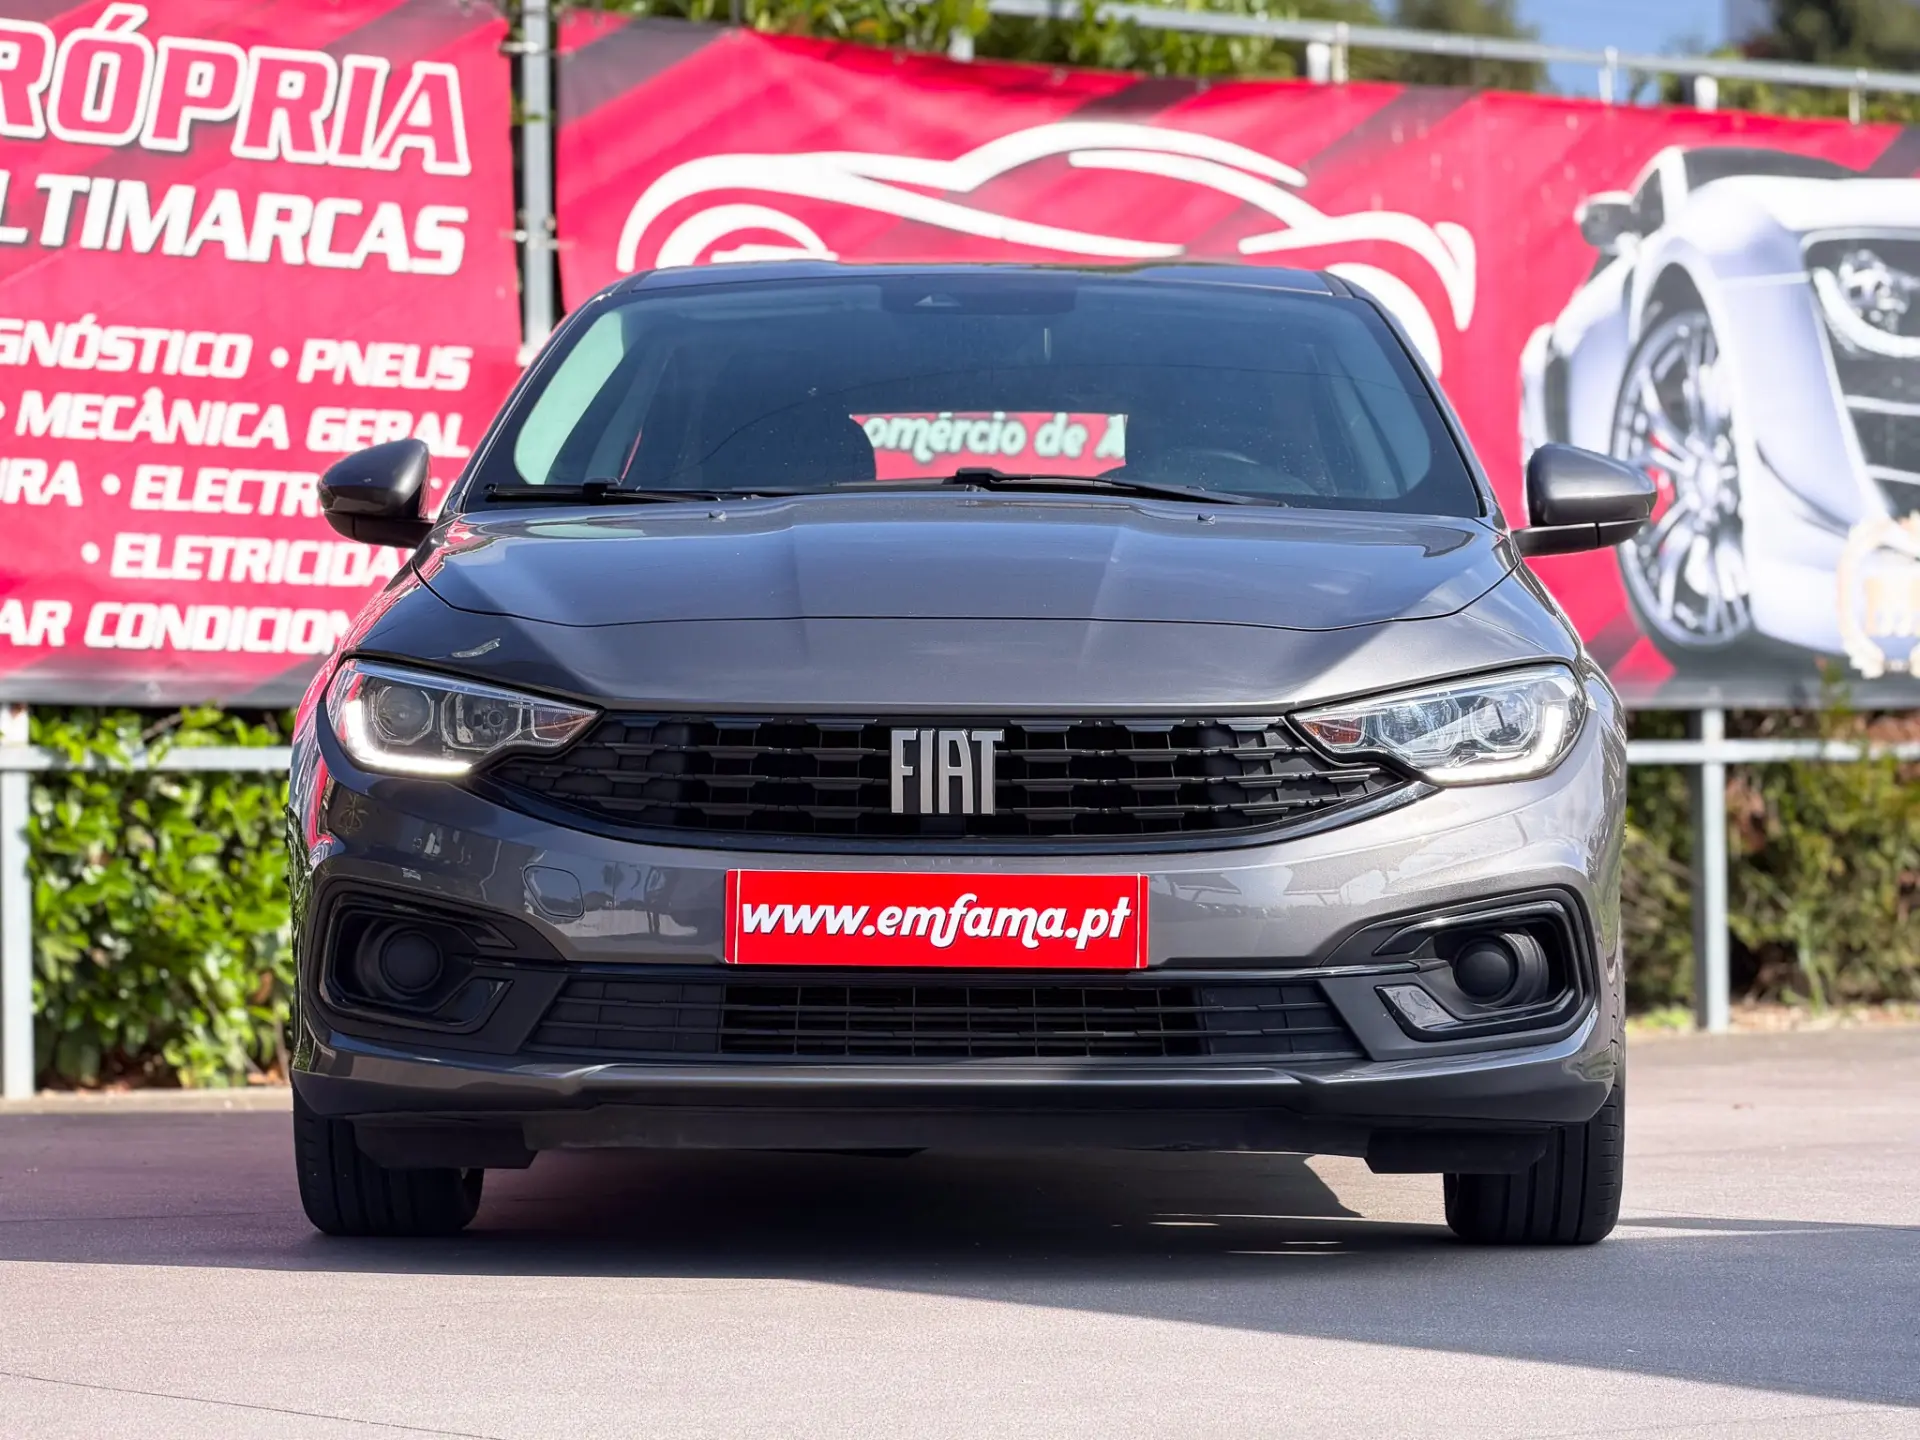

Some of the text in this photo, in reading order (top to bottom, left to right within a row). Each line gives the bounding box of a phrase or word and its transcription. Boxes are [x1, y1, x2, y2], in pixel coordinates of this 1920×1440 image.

[297, 338, 473, 391] PNEUS
[15, 387, 470, 457] MECÂNICA GERAL
[1034, 411, 1087, 458] de
[0, 457, 323, 517] RA ELECTR
[110, 532, 408, 587] ELETRICIDA
[0, 598, 73, 648] AR
[890, 728, 1004, 815] FIAT
[742, 893, 1131, 950] www.emfama.pt
